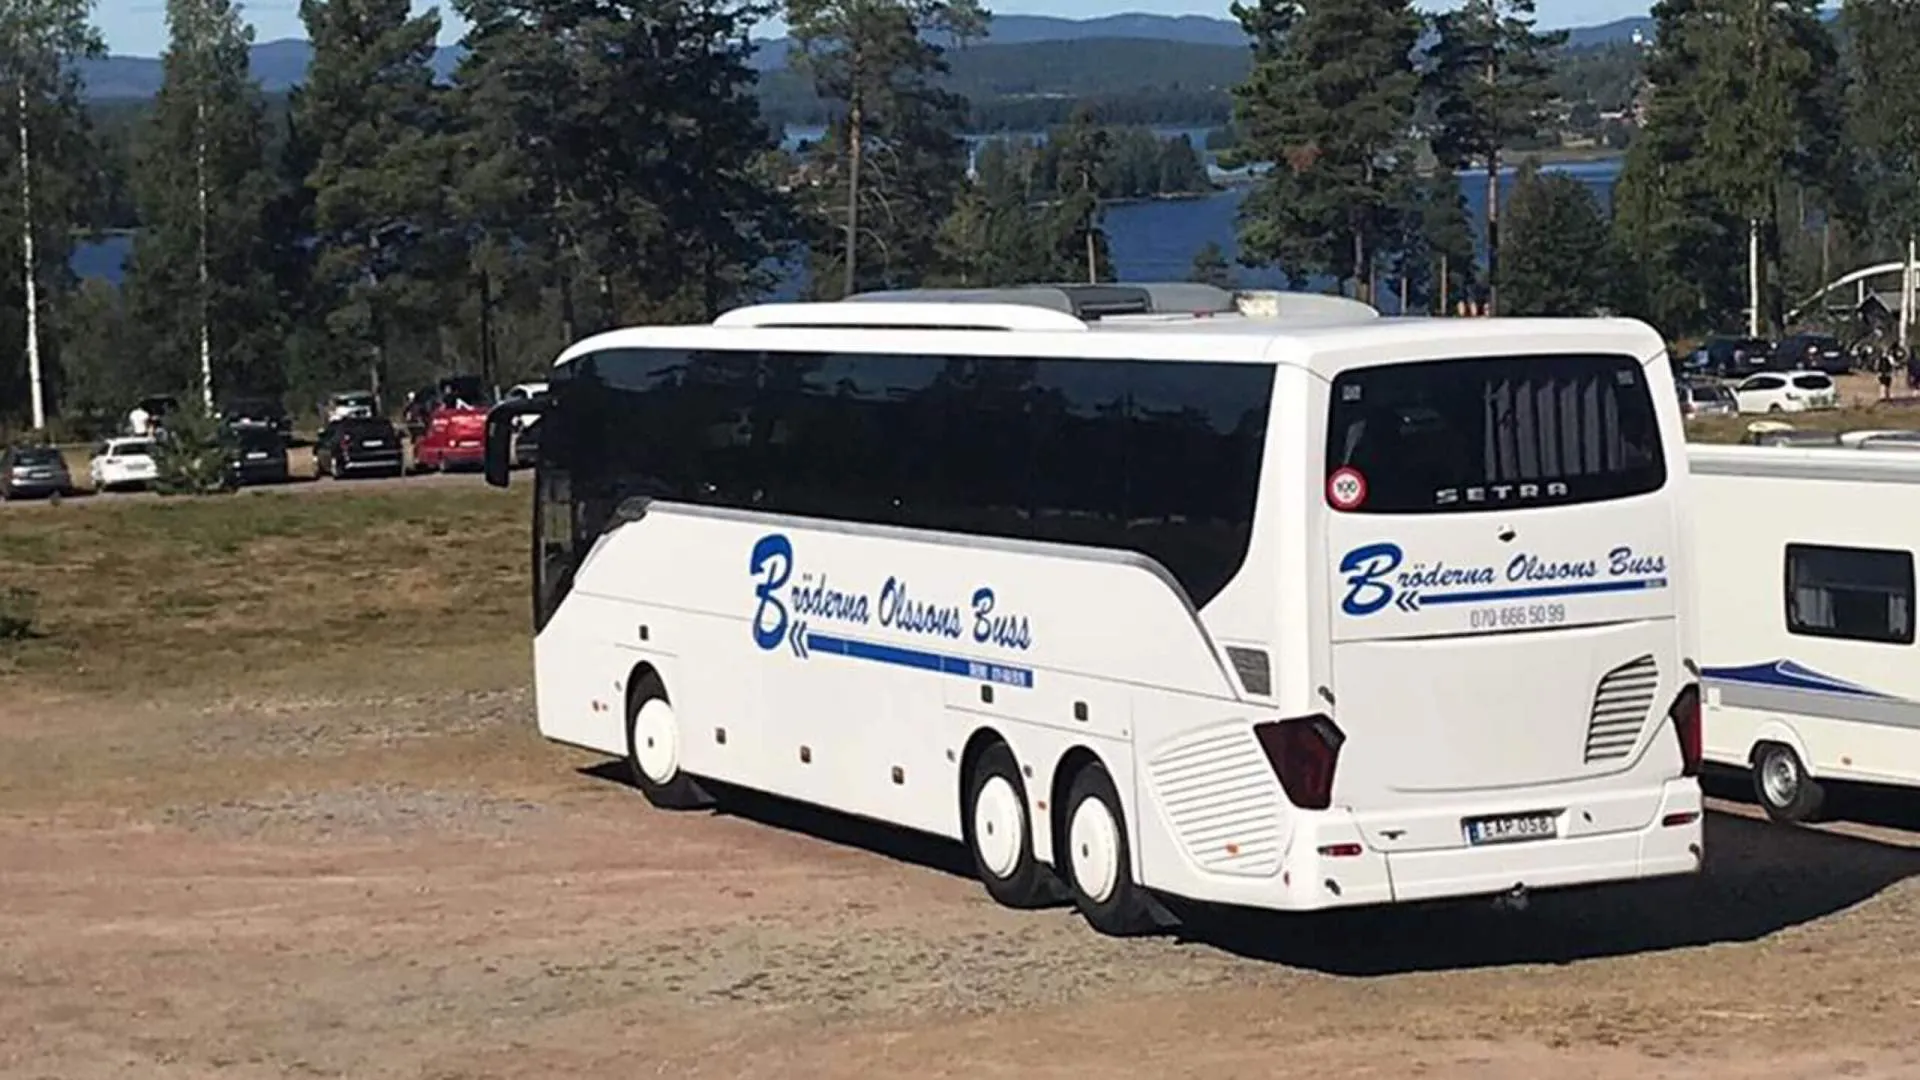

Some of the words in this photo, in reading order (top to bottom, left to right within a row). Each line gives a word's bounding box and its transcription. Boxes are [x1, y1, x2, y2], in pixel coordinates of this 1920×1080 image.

[1436, 483, 1568, 504] SETRA
[750, 533, 869, 650] Bröderna
[879, 575, 963, 639] Olssons
[971, 587, 1031, 650] Buss
[1340, 543, 1496, 615] Bröderna
[1506, 553, 1596, 582] Olssons
[1608, 547, 1666, 575] Buss
[1528, 604, 1546, 624] 50
